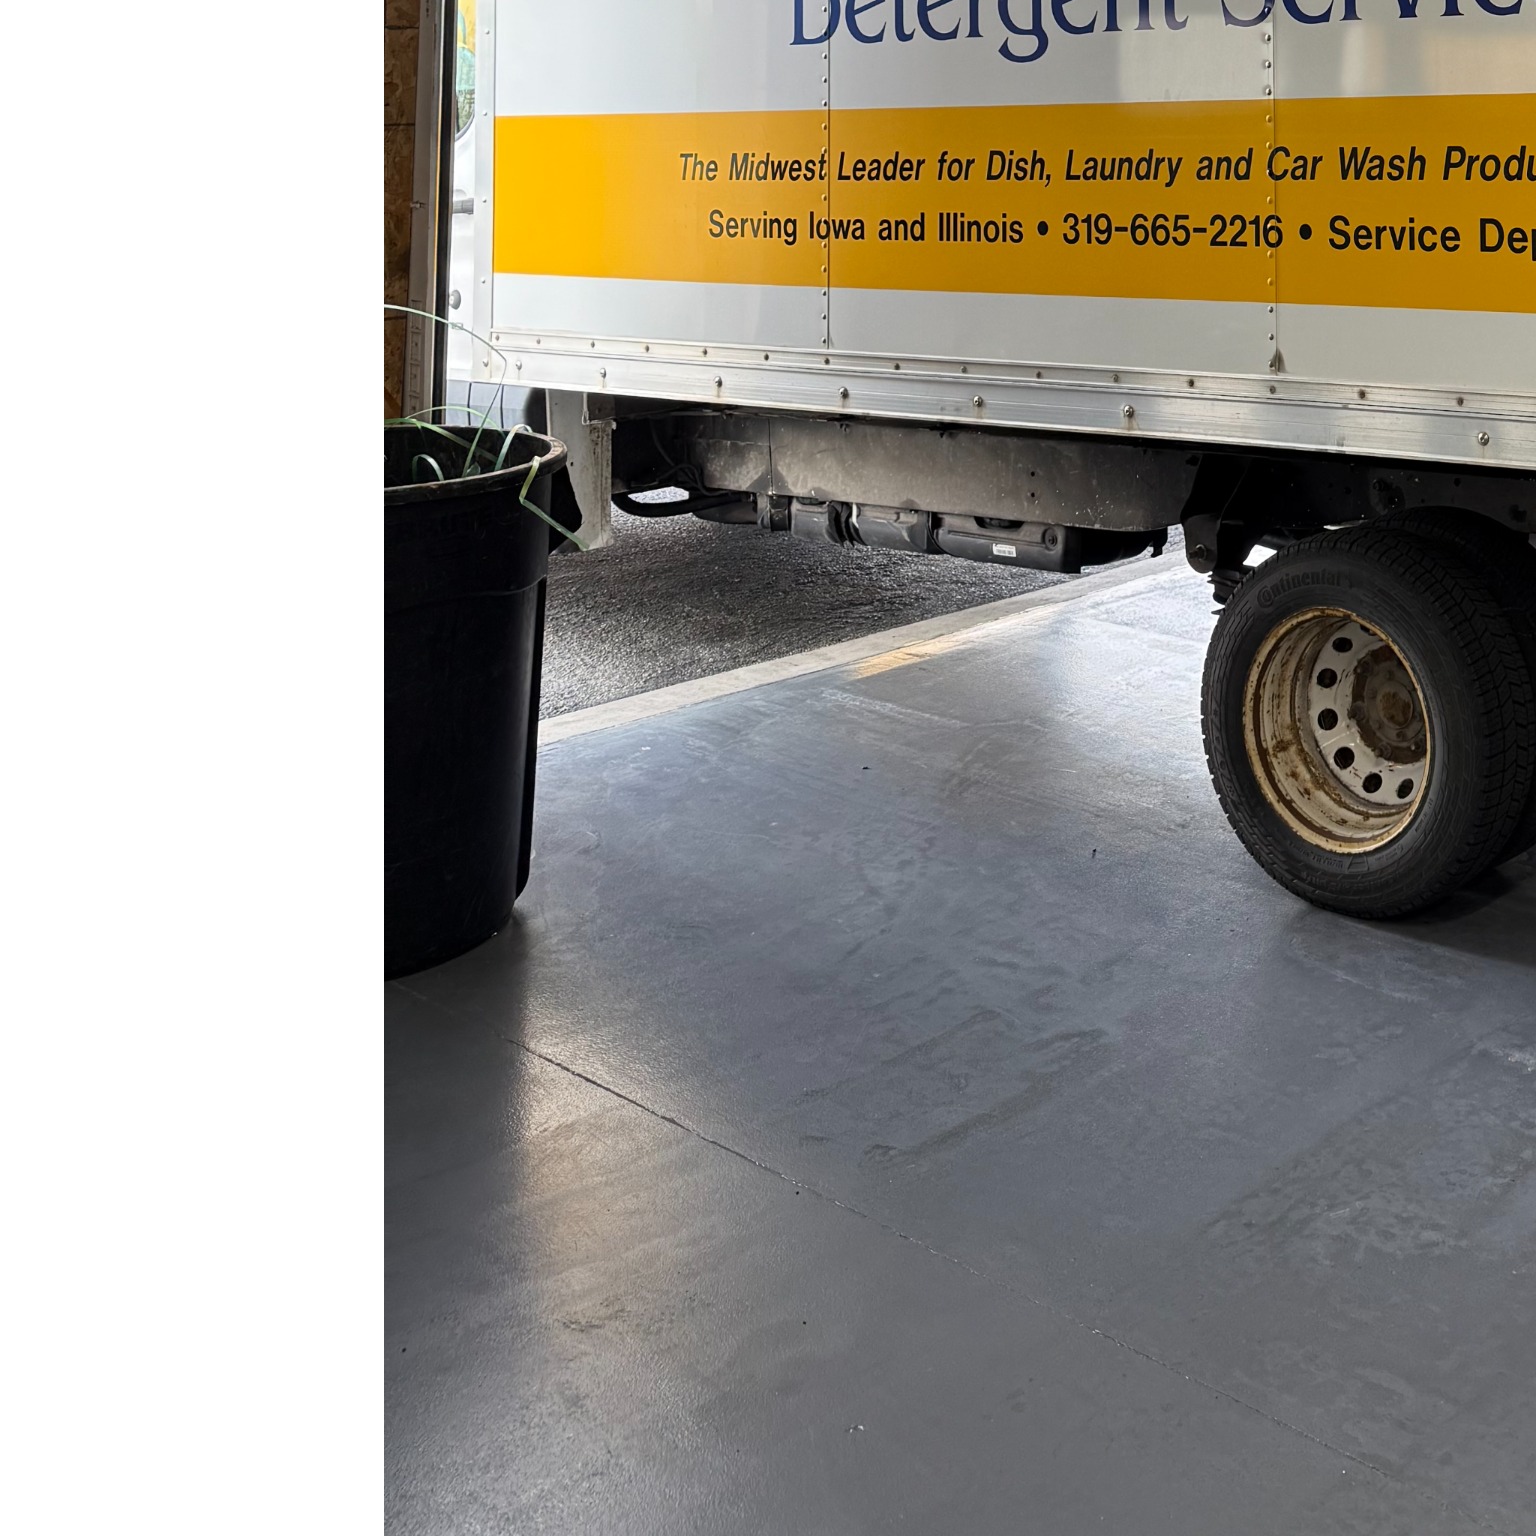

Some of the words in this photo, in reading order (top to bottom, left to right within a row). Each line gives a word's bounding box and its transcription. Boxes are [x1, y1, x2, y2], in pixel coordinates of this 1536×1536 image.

[680, 153, 717, 181] The
[729, 150, 828, 182] Midwest
[838, 151, 925, 181] Leader
[938, 151, 975, 181] for
[987, 150, 1051, 187] Dish,
[1066, 149, 1183, 187] Laundry
[1196, 148, 1253, 180] and
[1268, 146, 1323, 181] Car
[1339, 146, 1426, 181] Wash
[708, 210, 797, 245] Serving
[809, 210, 866, 242] Iowa
[879, 212, 925, 241] and
[939, 213, 1023, 243] Illinois
[1063, 213, 1283, 248] 319-665-2216
[1329, 215, 1460, 252] Service
[1257, 568, 1341, 609] Continental
